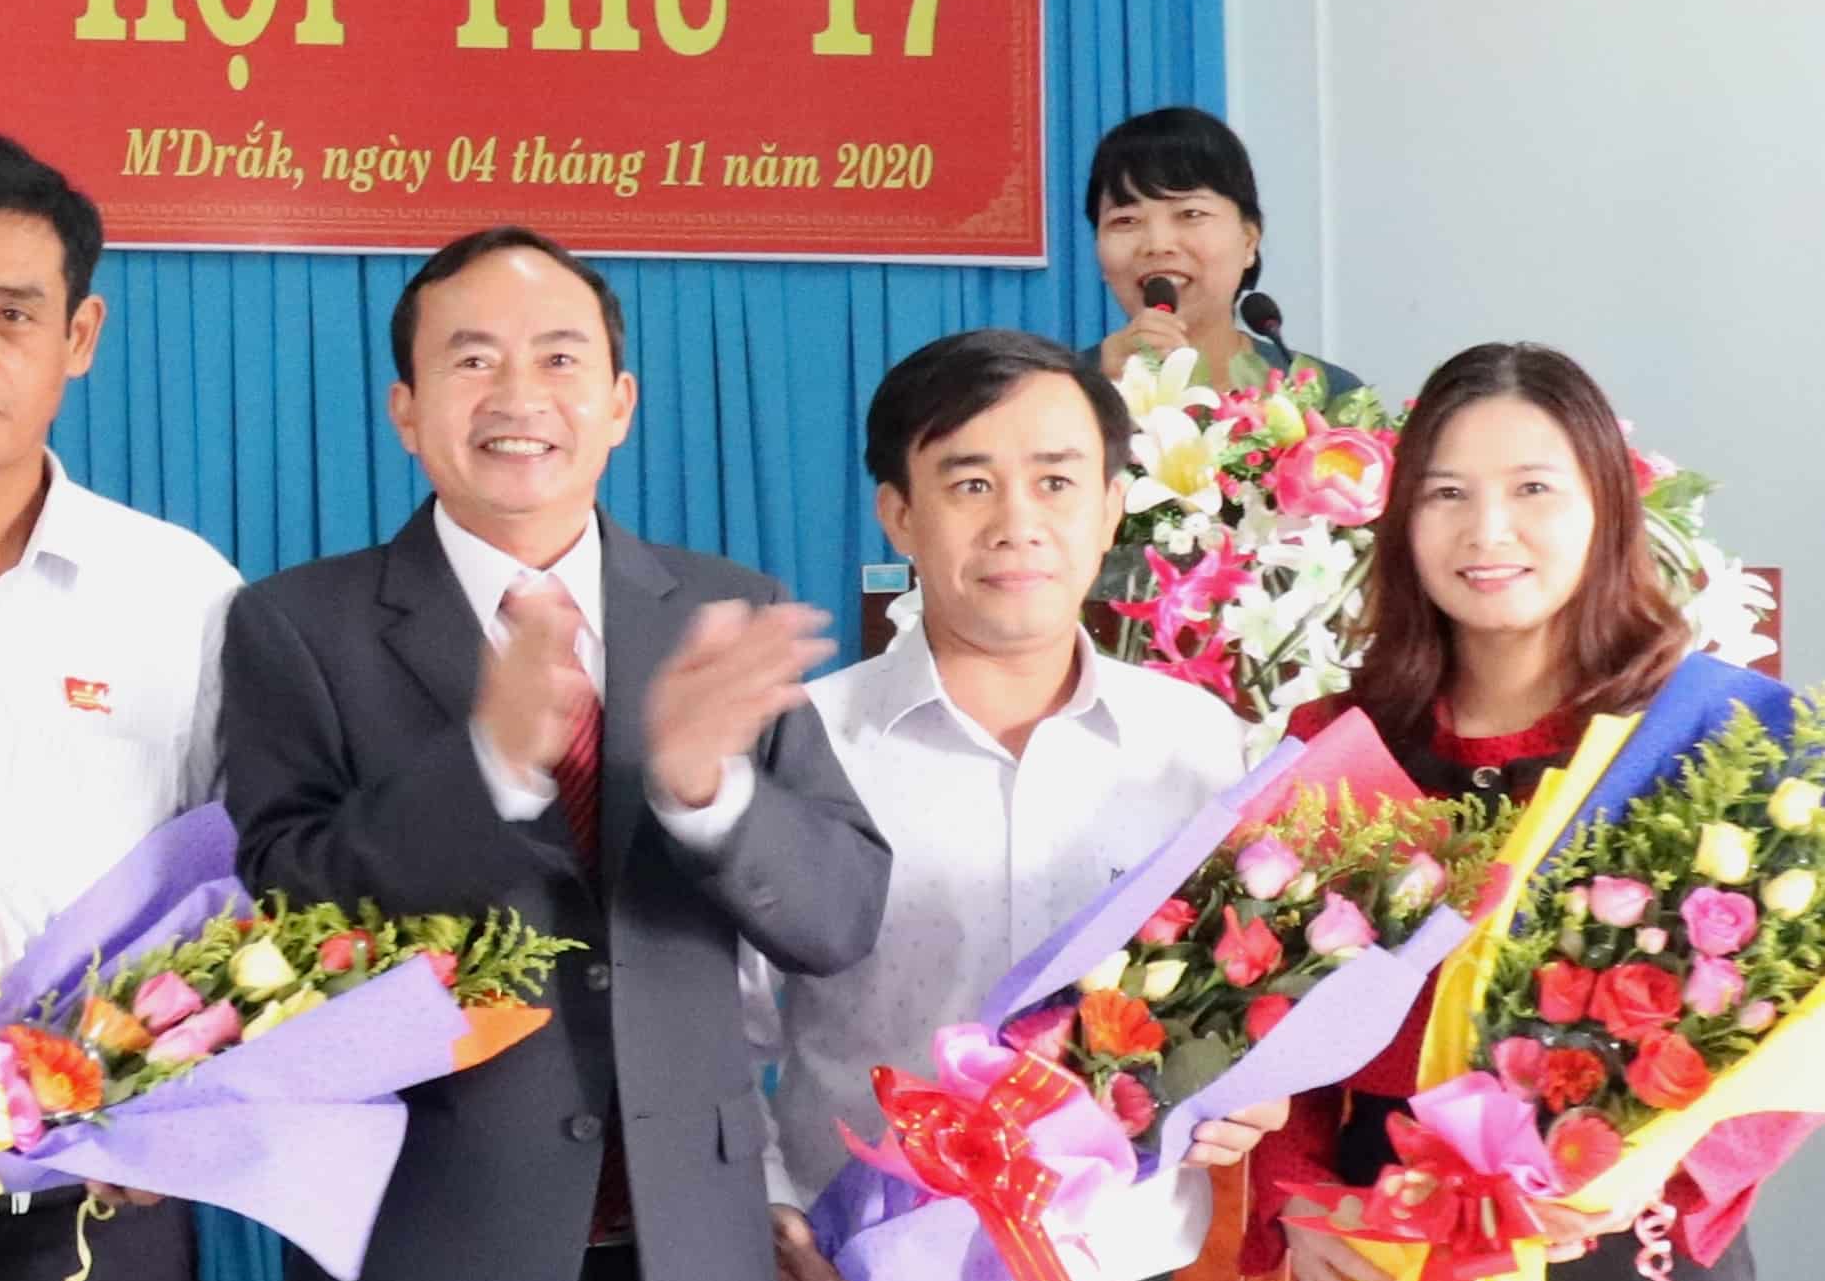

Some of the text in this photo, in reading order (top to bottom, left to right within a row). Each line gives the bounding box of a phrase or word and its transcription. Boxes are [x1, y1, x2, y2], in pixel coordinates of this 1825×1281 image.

[321, 134, 432, 194] ngày
[447, 135, 497, 183] 04
[511, 135, 646, 198] tháng
[660, 139, 706, 187] 11
[722, 142, 821, 188] năm
[833, 142, 933, 190] 2020
